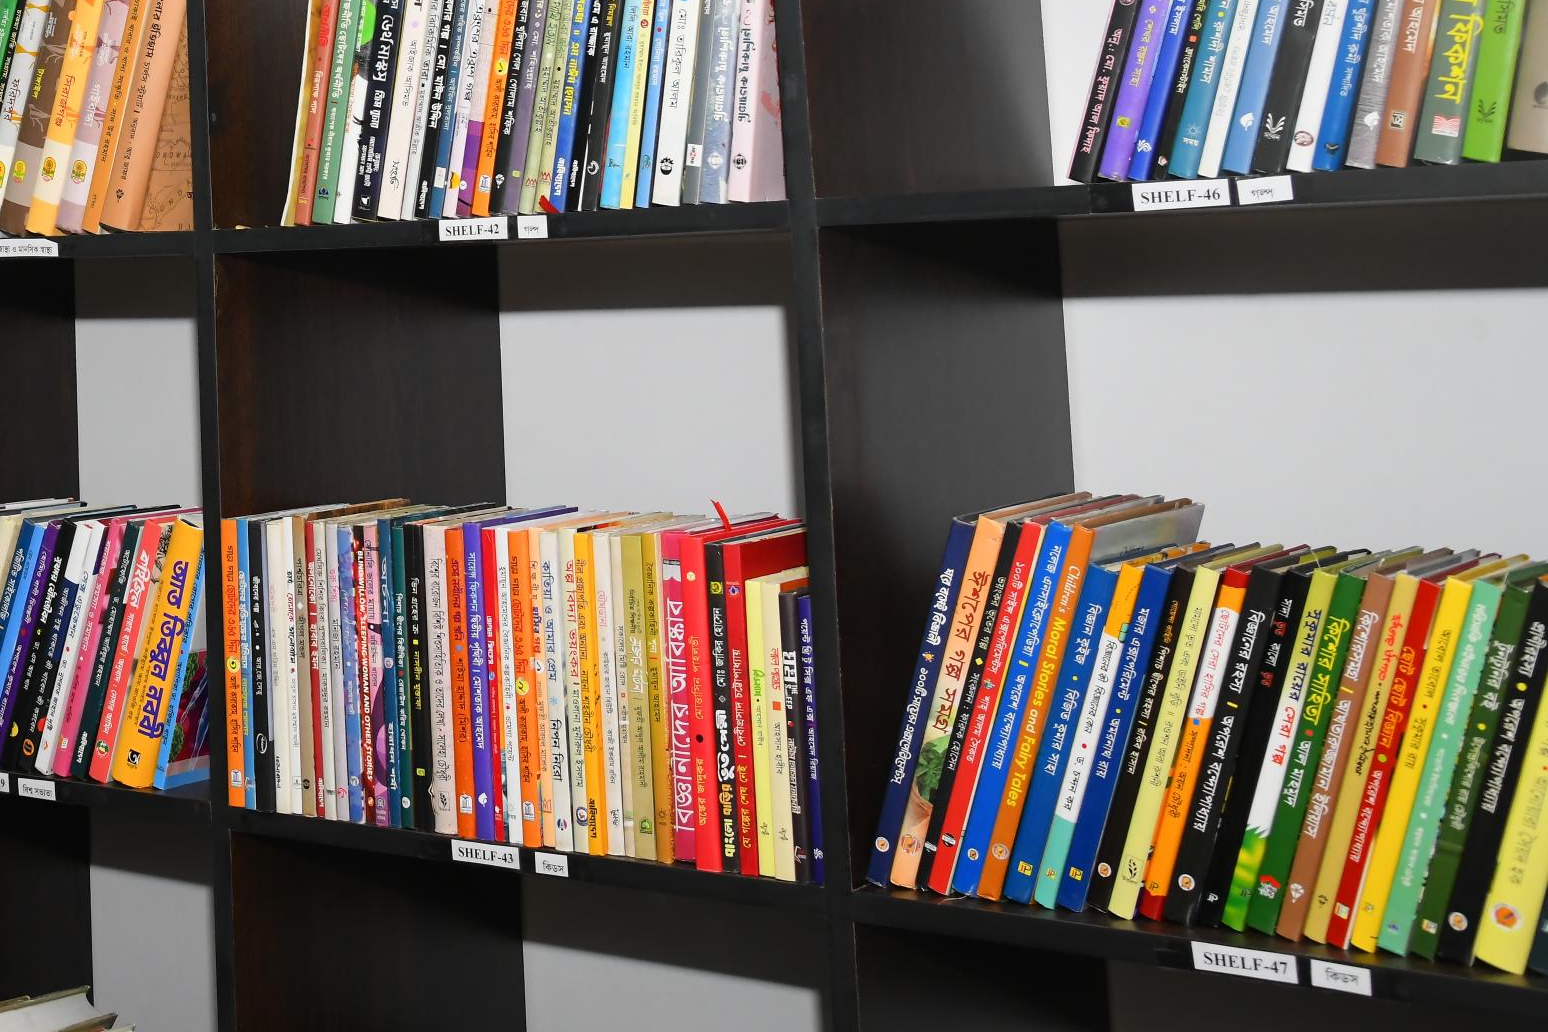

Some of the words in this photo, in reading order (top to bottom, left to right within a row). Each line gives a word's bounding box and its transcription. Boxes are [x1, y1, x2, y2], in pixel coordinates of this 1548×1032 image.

[438, 22, 452, 39] গল্প
[1164, 3, 1186, 36] ইসলাম
[1399, 5, 1423, 53] আহমেদ
[435, 54, 445, 70] মো.
[671, 35, 686, 74] তারিকুল
[1102, 54, 1114, 72] মো.
[1436, 13, 1483, 103] ফিকশন
[669, 79, 679, 108] আলম
[428, 102, 442, 128] উদ্দিন
[1089, 103, 1102, 124] আল
[1079, 126, 1099, 153] ফিদাহ
[1140, 187, 1221, 205] SHELF-46
[445, 223, 500, 237] SHELF-42
[467, 552, 476, 578] সায়েন্স
[1045, 545, 1061, 573] নলেজ
[166, 560, 188, 609] আত
[469, 581, 479, 612] ফিকশন
[542, 561, 554, 599] কাতিয়া
[1058, 565, 1080, 612] Children's
[542, 604, 557, 614] ও
[954, 570, 990, 642] ঈশপের
[1082, 603, 1102, 635] বিজ্ঞান
[1133, 608, 1149, 635] মজার
[470, 614, 481, 638] দ্বিতীয়
[545, 618, 554, 652] আমার
[1045, 616, 1066, 658] Moral
[1238, 609, 1265, 660] বিজ্ঞানের
[1300, 609, 1321, 656] সুকুমার
[1317, 616, 1349, 670] কিশোর
[469, 641, 483, 665] পৃথিবী
[664, 597, 690, 694] আবিষ্কার
[1074, 637, 1090, 664] কুইজ
[1344, 609, 1378, 681] কিশোরসমগ্র
[1518, 621, 1546, 676] প্রাণীরহস্য
[547, 657, 556, 681] প্রেম
[945, 650, 965, 681] গল্প
[1032, 660, 1054, 705] Stories
[1228, 662, 1248, 693] রহস্য
[1289, 662, 1308, 701] রায়ের
[362, 693, 371, 713] AND
[472, 676, 482, 713] মোশতাক
[1007, 674, 1025, 710] অপরেশ
[1060, 688, 1079, 721] বিজিত
[1303, 673, 1330, 725] সাহিত্য
[137, 685, 164, 738] নববী
[932, 687, 956, 733] সমগ্র
[1025, 708, 1037, 733] and
[1278, 706, 1295, 738] সেরা
[1500, 698, 1524, 741] অপরেশ
[475, 715, 484, 749] আহমেদ
[991, 712, 1015, 769] বন্দ্যোপাধ্যায়
[1051, 723, 1067, 750] কুমার
[1101, 718, 1120, 758] অমরনাথ
[1211, 715, 1234, 759] অপরেশ
[363, 743, 372, 779] STORIES
[552, 752, 564, 781] নিরো
[668, 699, 695, 833] বিজ্ঞানীদের
[1015, 735, 1035, 769] Fairy
[1043, 753, 1059, 775] সাহা
[1095, 760, 1108, 778] রায়
[1272, 744, 1286, 764] গল্প
[1294, 740, 1311, 765] আল
[1006, 772, 1025, 806] Tales
[1282, 768, 1304, 807] মাহমুদ
[1481, 743, 1512, 813] বন্দ্যোপাধ্যায়
[1193, 762, 1222, 832] বন্দ্যোপাধ্যায়
[1304, 792, 1330, 838] ইলিয়াস
[458, 846, 514, 864] SHELF-43
[1203, 951, 1288, 975] SHELF-47
